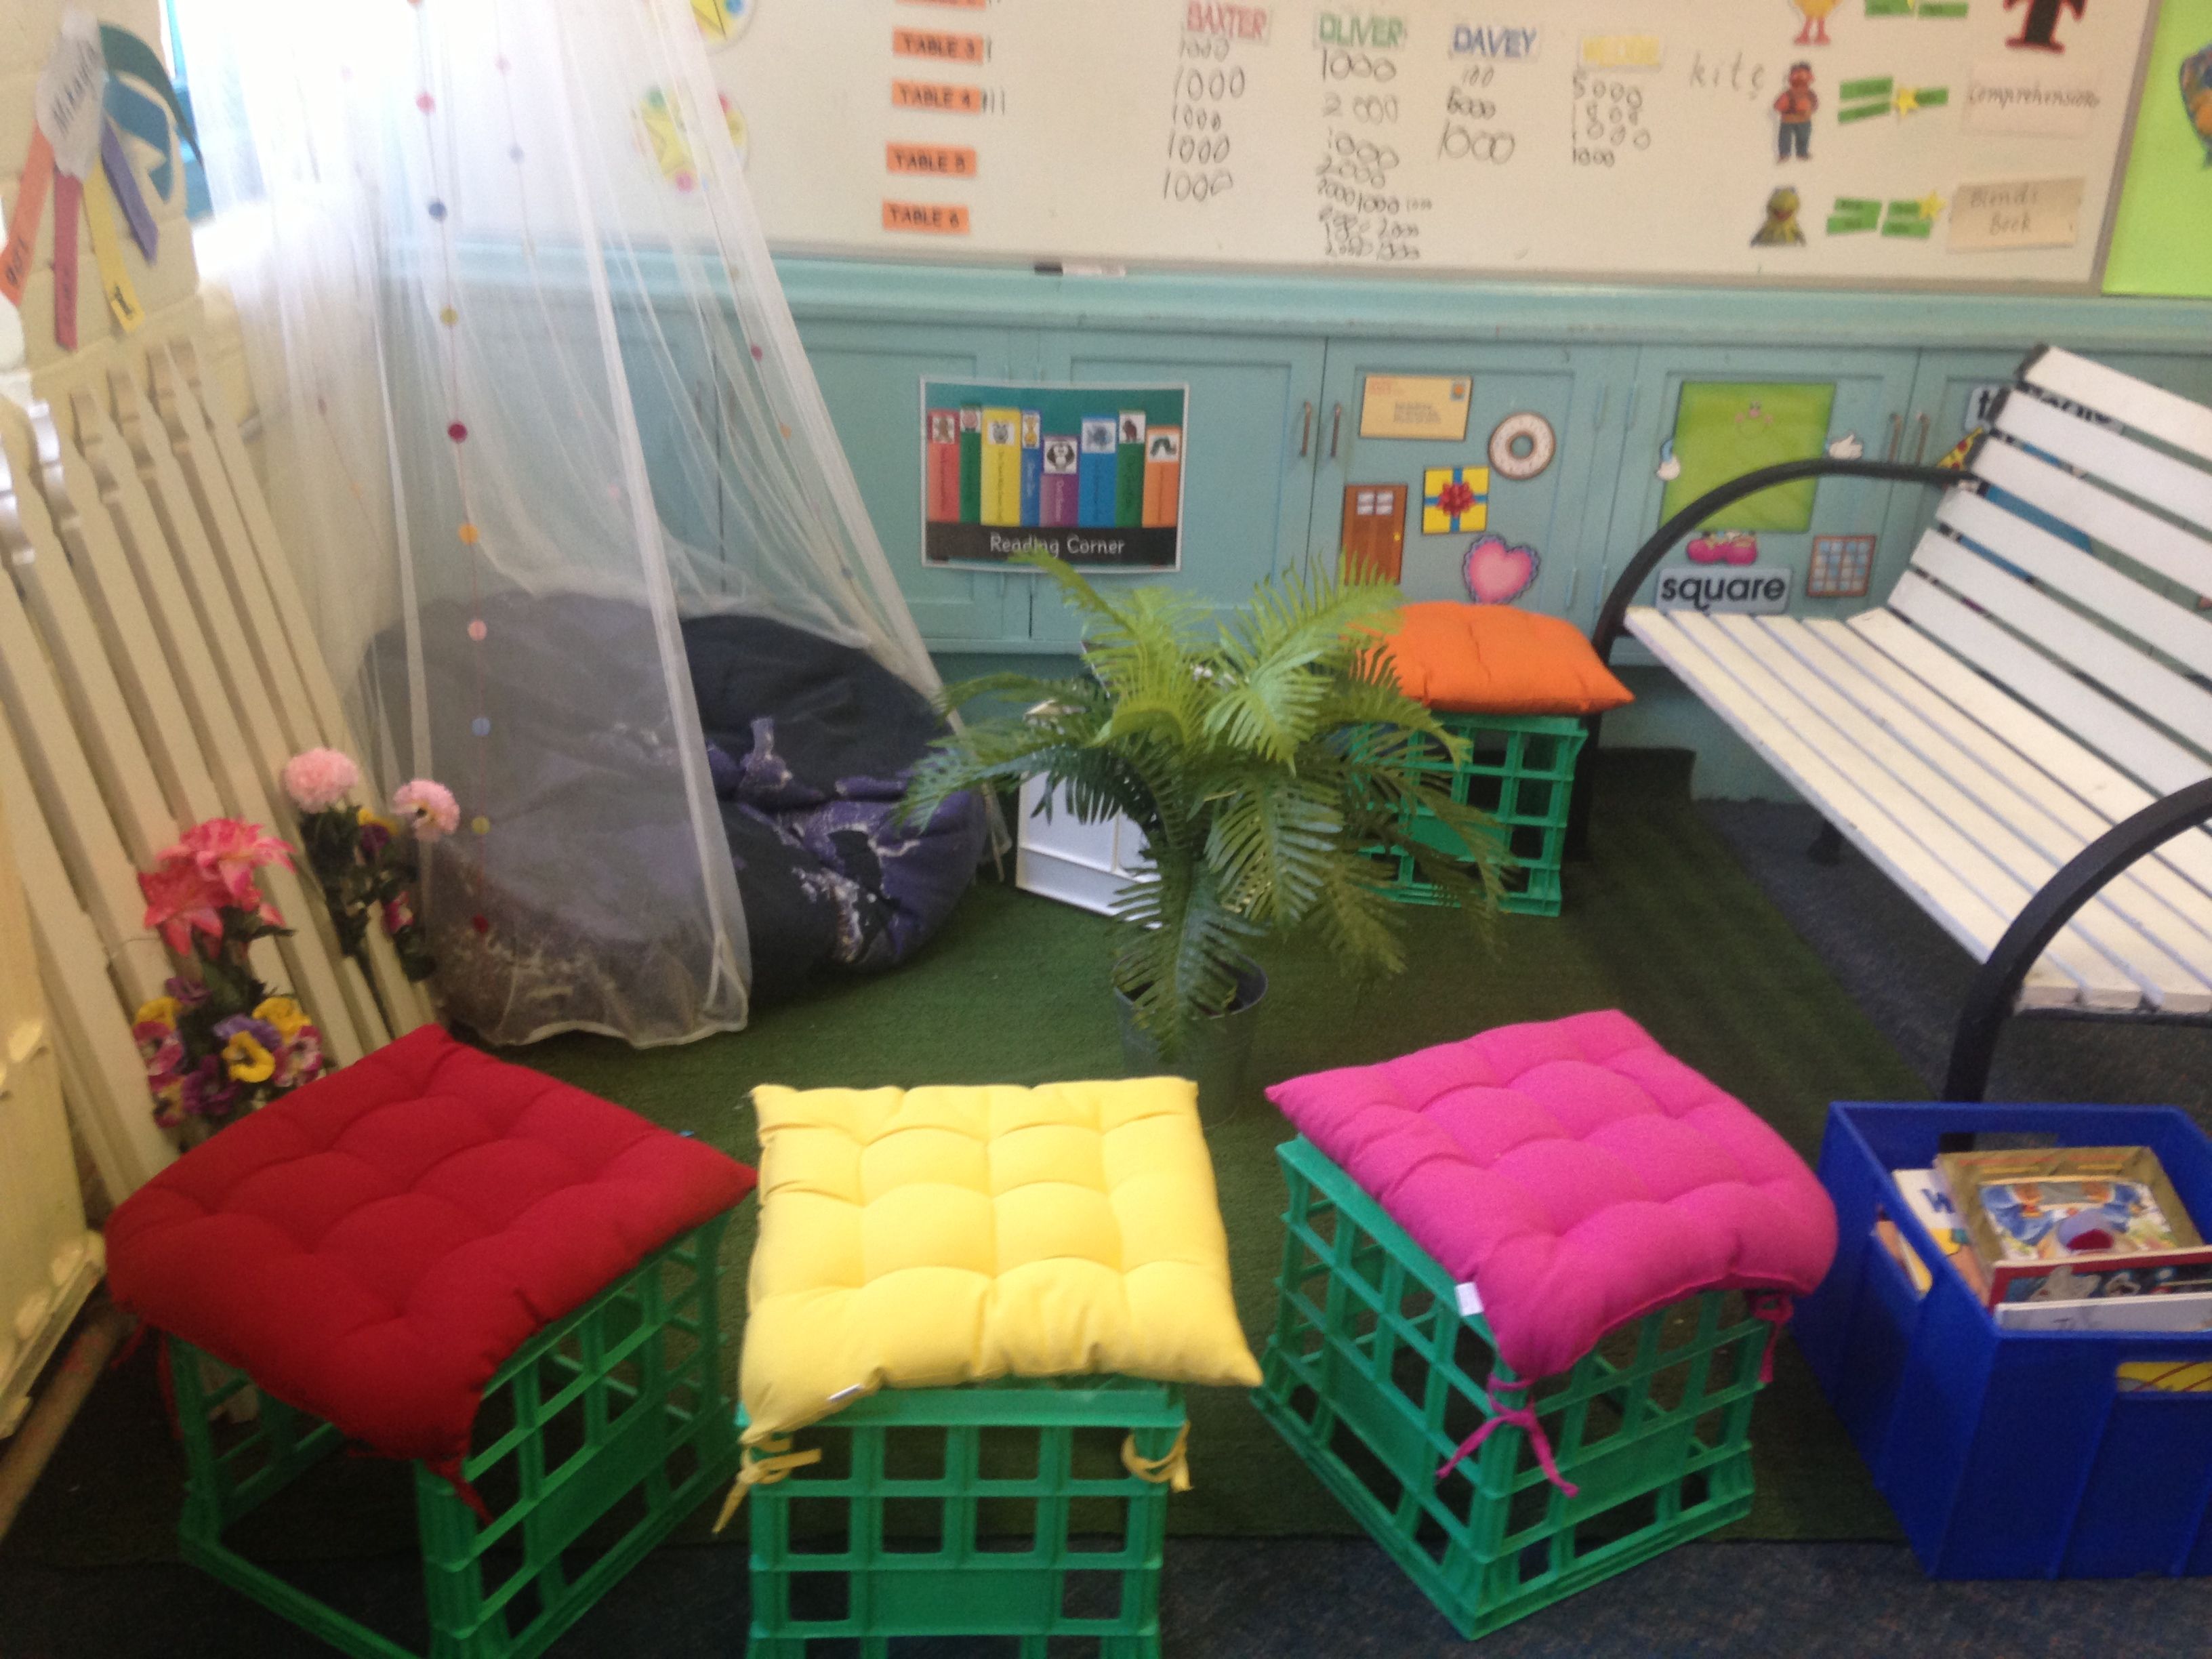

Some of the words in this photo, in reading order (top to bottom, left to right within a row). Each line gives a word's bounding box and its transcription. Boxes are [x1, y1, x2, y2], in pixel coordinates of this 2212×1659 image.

[1187, 1, 1267, 39] BAXTER
[1318, 12, 1404, 48] OLIVER
[902, 31, 958, 58] TABLE
[1453, 24, 1538, 58] DAVEY
[1323, 47, 1397, 83] 1000
[898, 82, 954, 110] TABLE
[1172, 65, 1246, 102] 1000
[1172, 103, 1222, 132] 1000
[1168, 129, 1230, 165] 1000
[1437, 118, 1516, 165] 1000
[894, 148, 948, 173] TABLE
[888, 203, 942, 228] TABLE
[989, 531, 1059, 558] Reading
[1066, 532, 1125, 555] Corner
[1661, 577, 1786, 611] square
